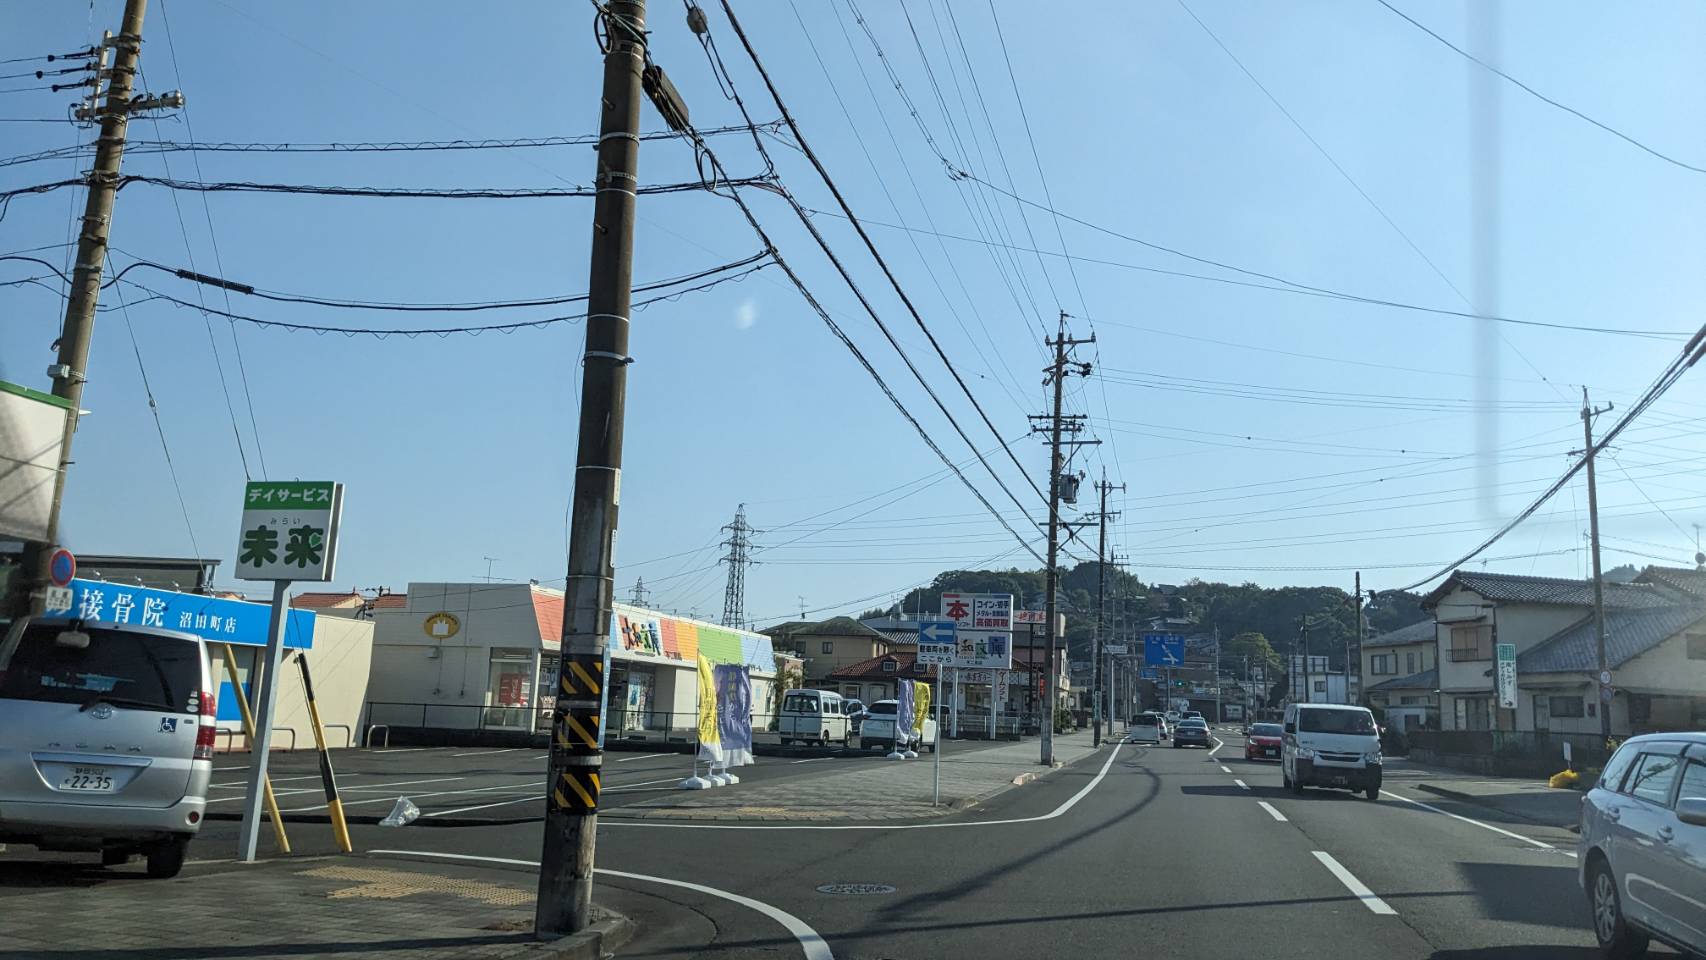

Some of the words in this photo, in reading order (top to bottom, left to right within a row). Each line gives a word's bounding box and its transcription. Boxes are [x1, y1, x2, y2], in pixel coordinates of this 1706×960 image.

[249, 488, 329, 502] デイサービス
[270, 517, 301, 525] みらい
[240, 525, 324, 568] 未来
[920, 655, 952, 663] ここから
